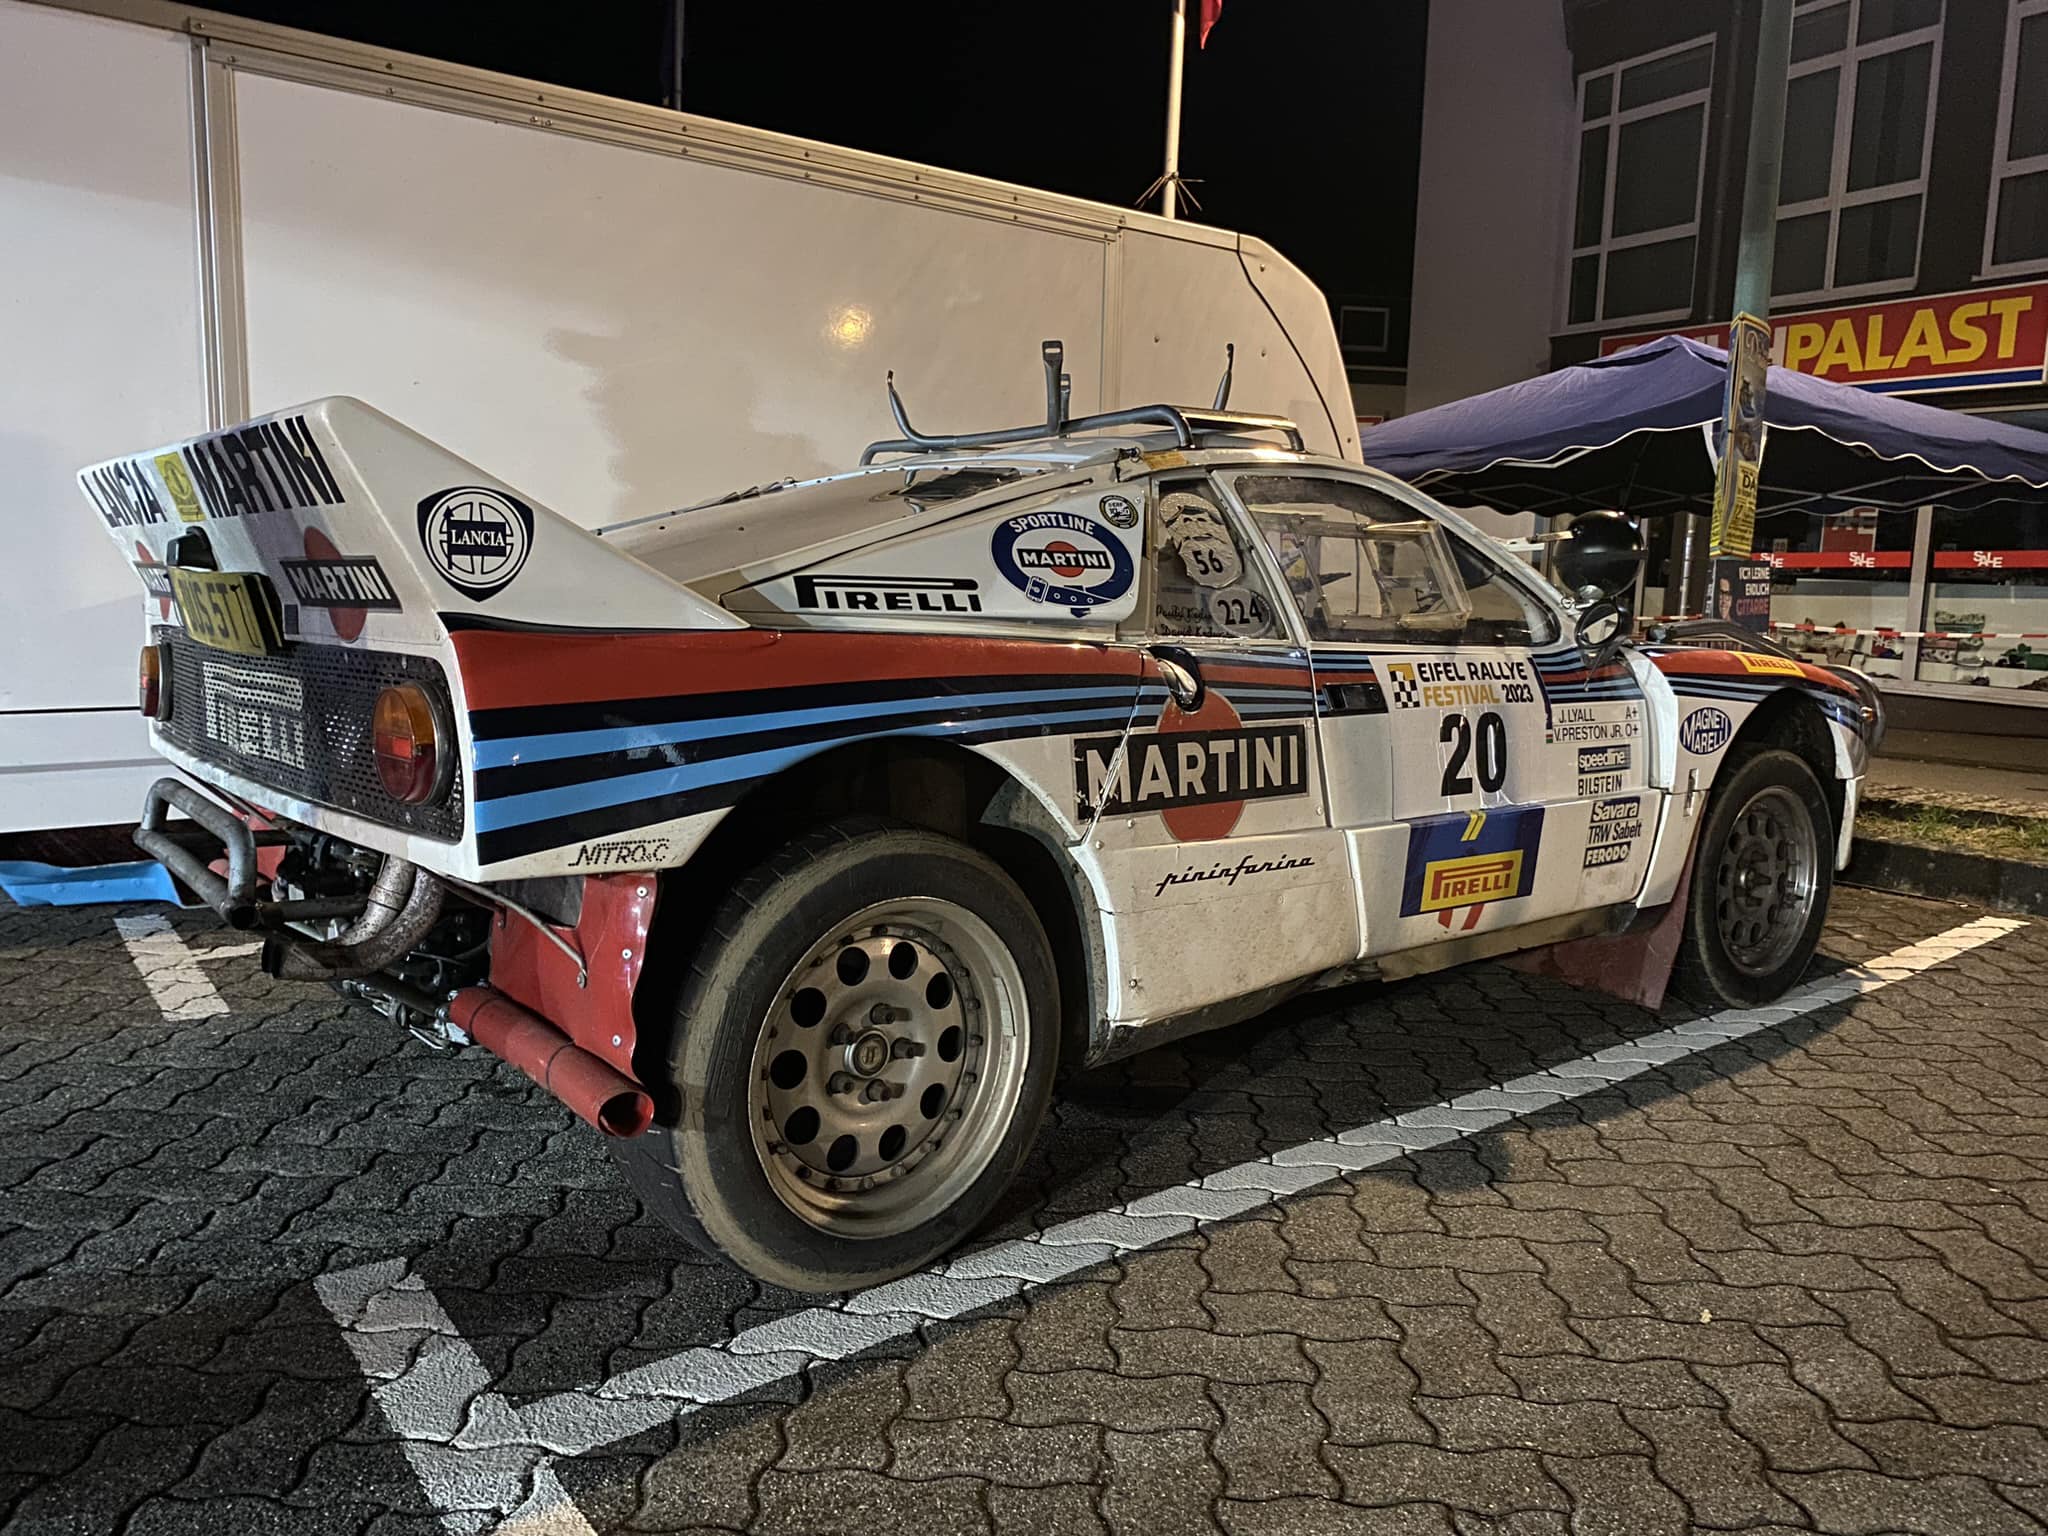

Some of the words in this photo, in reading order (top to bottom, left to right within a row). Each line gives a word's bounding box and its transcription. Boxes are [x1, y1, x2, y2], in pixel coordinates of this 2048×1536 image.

[80, 459, 167, 528] LANCIA
[182, 415, 345, 519] MARTINI
[1009, 513, 1095, 535] SPORTLINE
[451, 529, 506, 547] LANCIA
[1022, 552, 1107, 569] MARTINI
[1192, 550, 1223, 575] 56
[1849, 551, 1875, 568] SALE
[1973, 551, 2003, 568] SALE
[290, 563, 392, 600] MARTINI
[793, 575, 982, 612] PIRELLI
[1217, 599, 1263, 625] 224
[1418, 662, 1466, 682] EIFEL
[1469, 661, 1528, 681] RALLYE
[1746, 656, 1797, 671] PIRELLI
[1423, 685, 1500, 707] FESTIVAL
[1502, 683, 1534, 704] 2023
[1625, 706, 1638, 720] A+
[1440, 711, 1507, 797] 20
[1579, 751, 1625, 771] speedline
[1086, 735, 1299, 803] MARTINI
[1578, 774, 1623, 796] BILSTEIN
[1592, 800, 1638, 821] Savara
[1588, 823, 1612, 844] TRW
[1612, 819, 1642, 840] Sabelt
[1585, 844, 1629, 865] FERODO
[1154, 854, 1315, 897] pininfarina
[1430, 860, 1514, 900] PIRELLI
